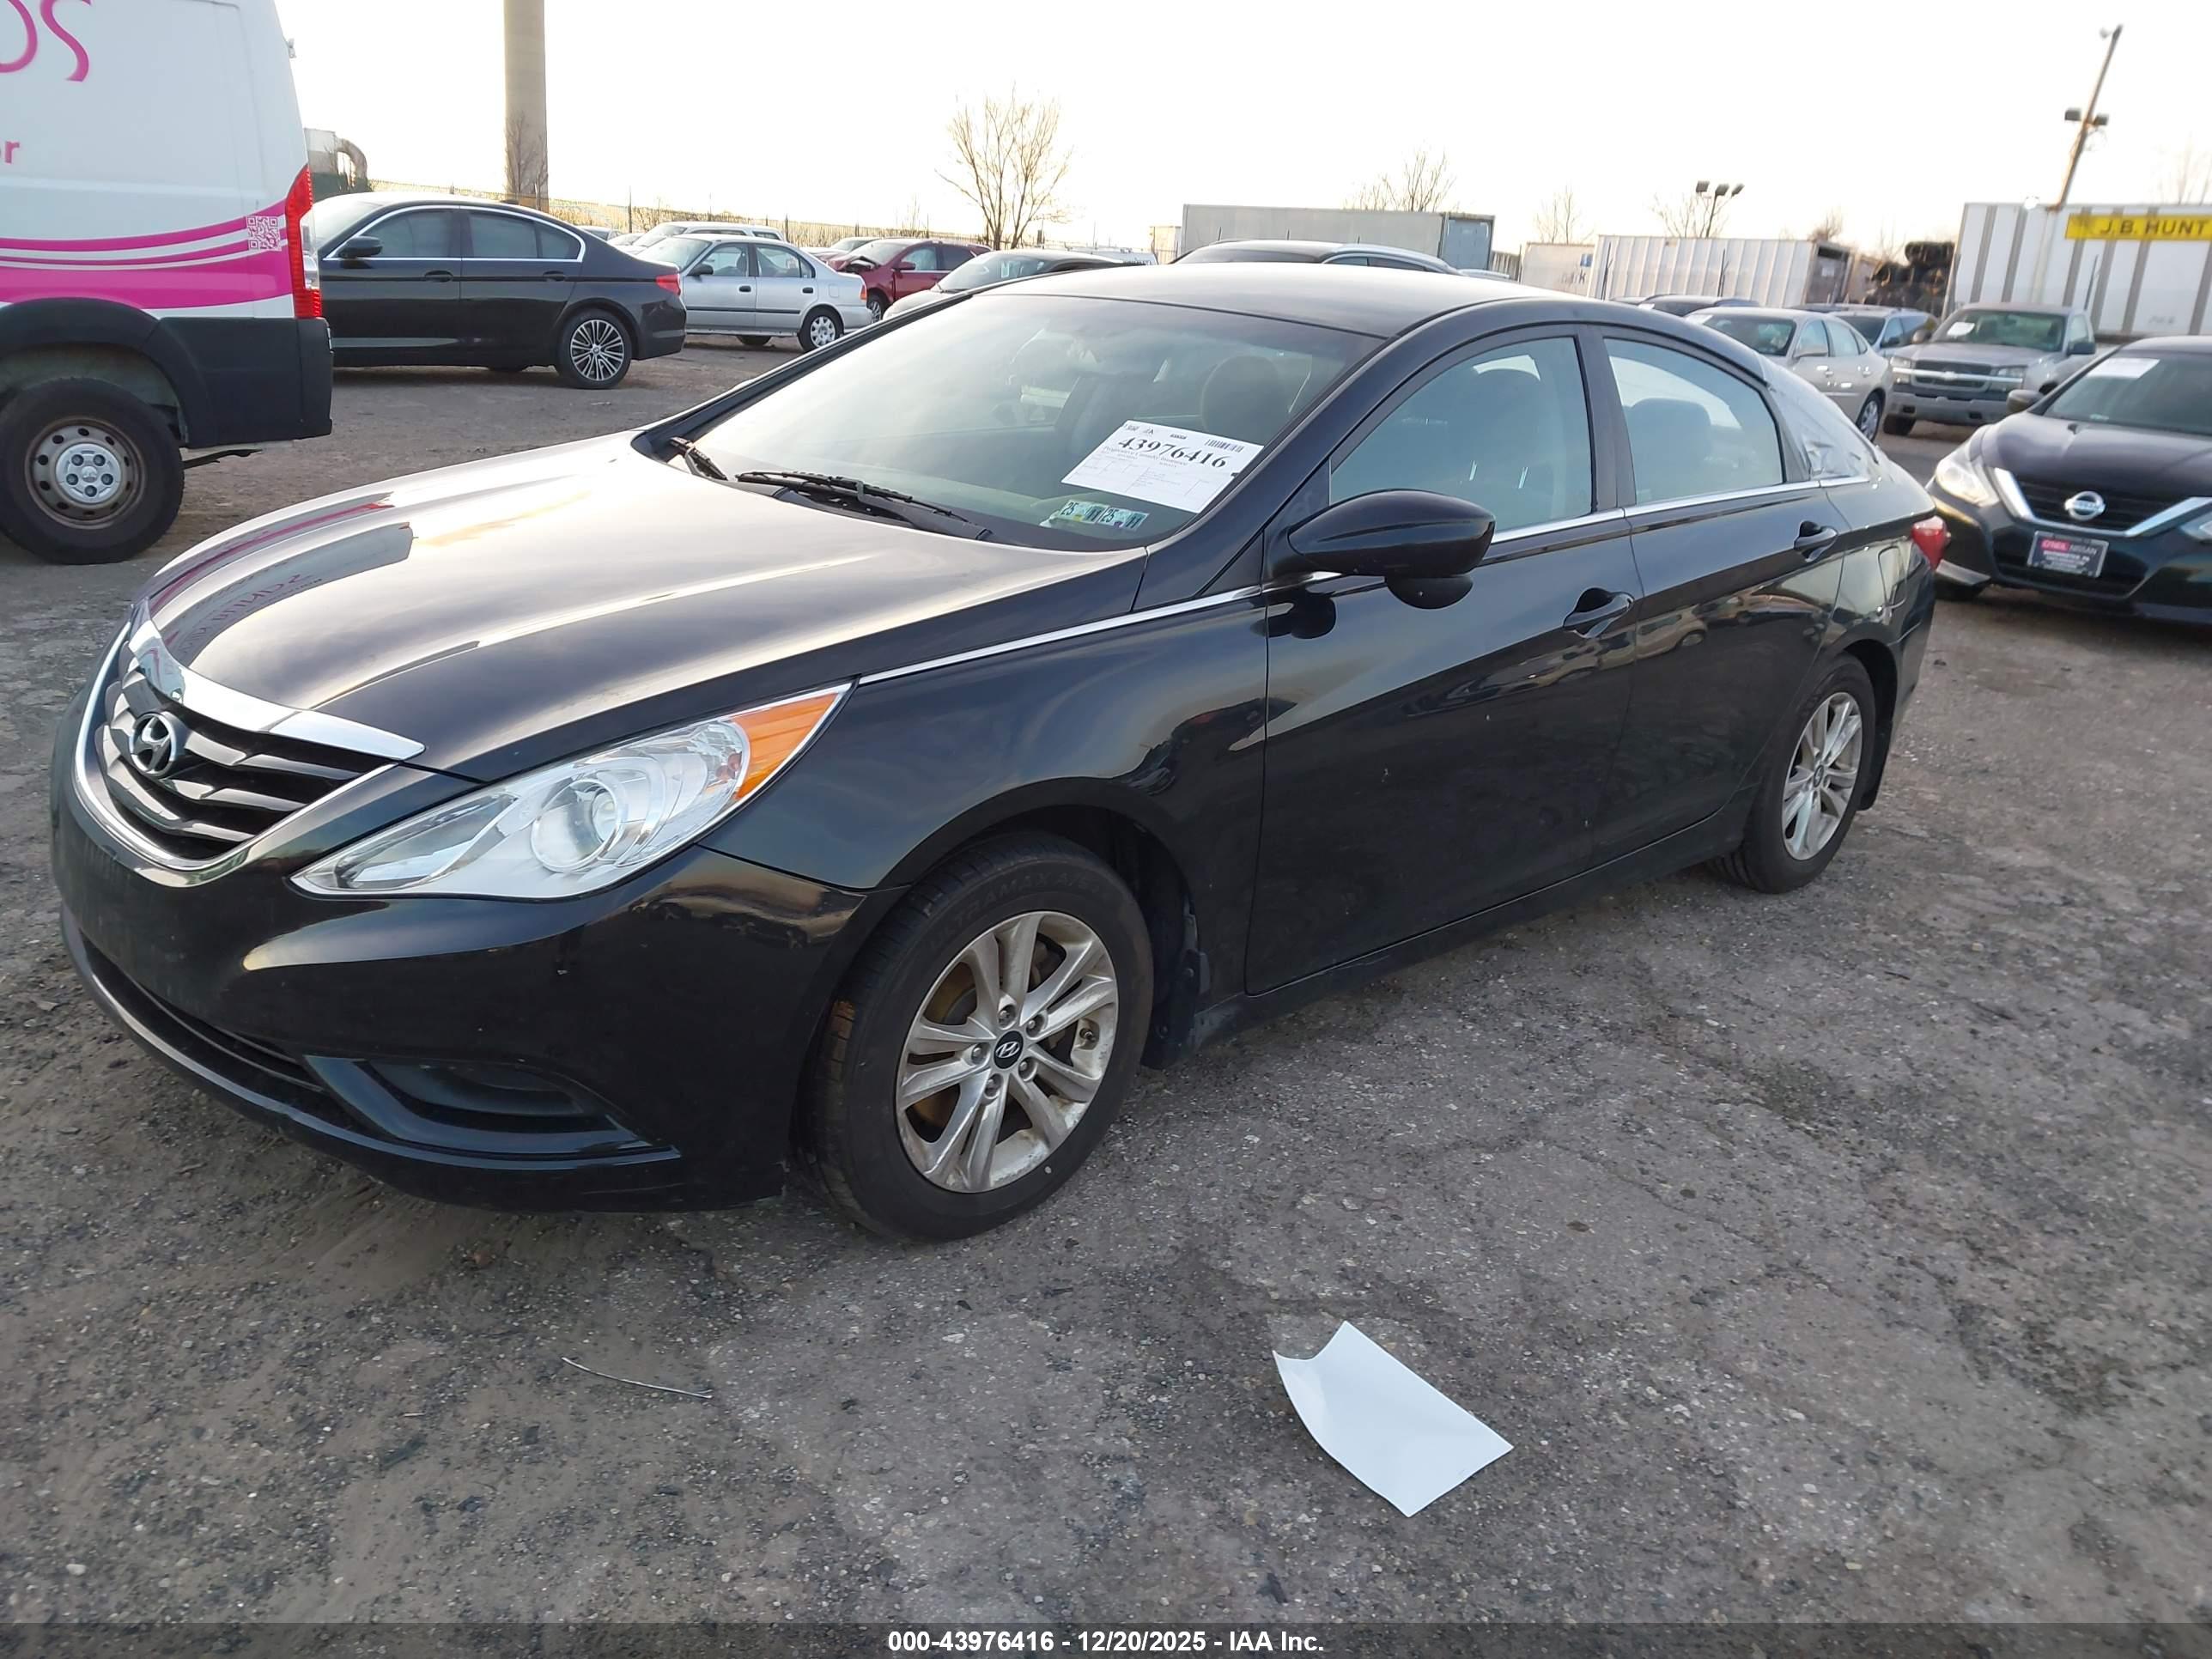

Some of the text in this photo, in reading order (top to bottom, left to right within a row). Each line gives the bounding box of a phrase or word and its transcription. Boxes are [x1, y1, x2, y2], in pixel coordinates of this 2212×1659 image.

[2144, 219, 2209, 235] HUNT
[1118, 436, 1227, 468] 43976416
[1061, 502, 1079, 515] 25
[1100, 509, 1119, 522] 25
